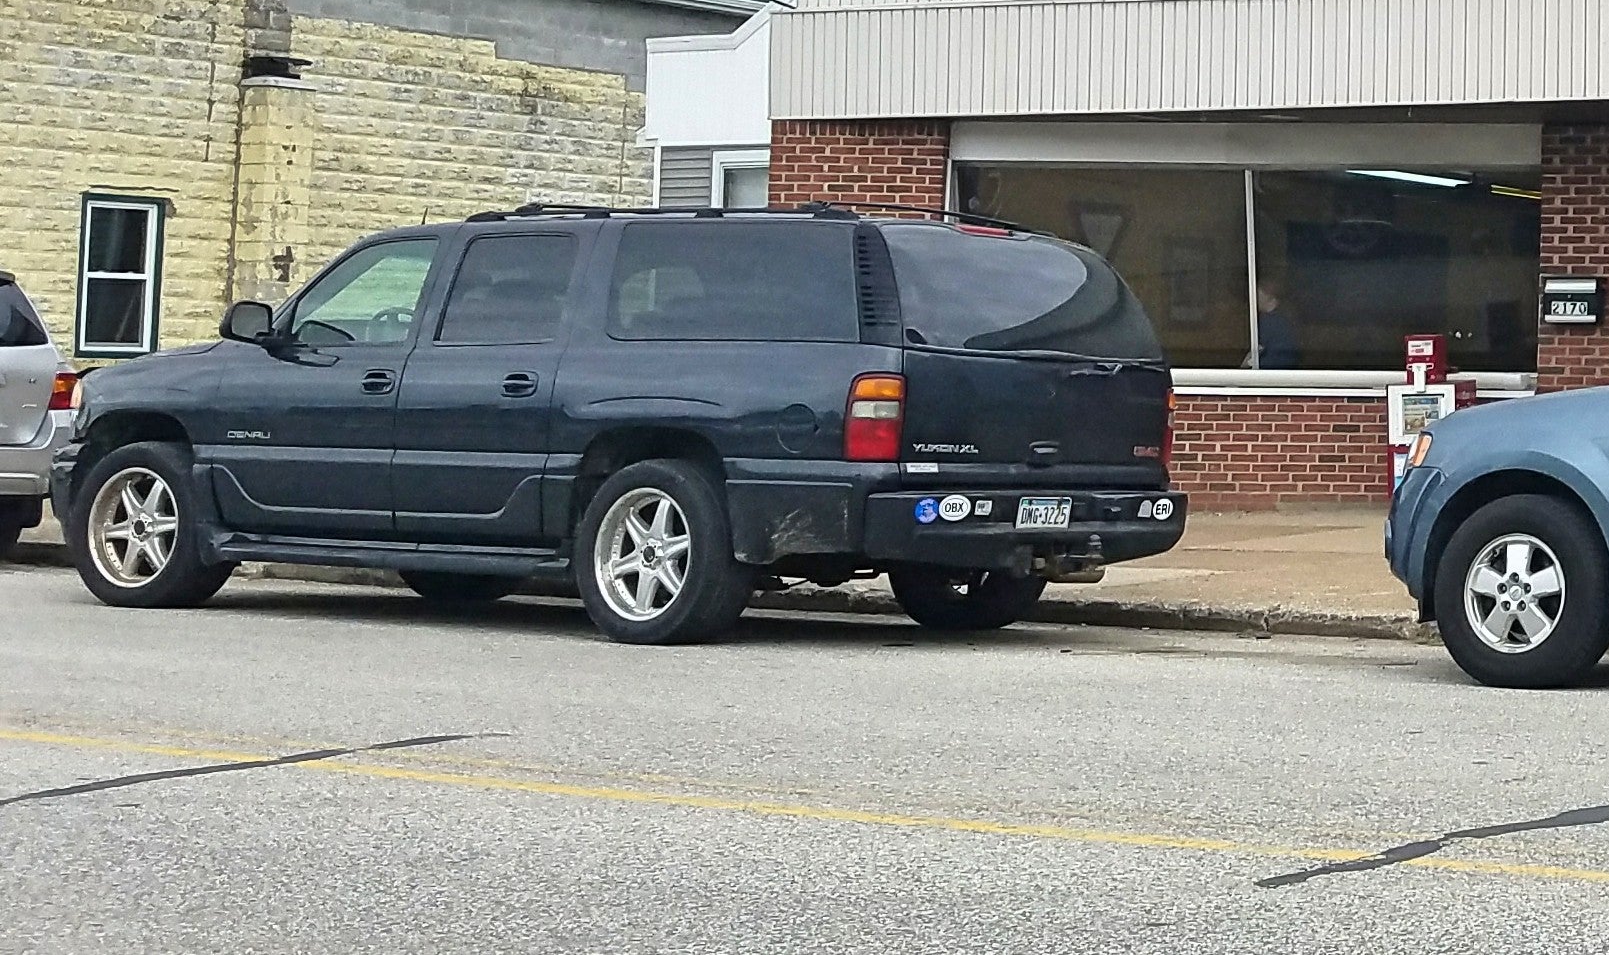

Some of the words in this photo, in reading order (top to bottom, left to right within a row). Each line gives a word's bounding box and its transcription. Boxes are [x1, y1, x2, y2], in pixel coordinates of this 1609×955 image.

[1552, 302, 1587, 315] 2170
[227, 430, 271, 439] DENALI
[912, 443, 959, 453] YUKON
[960, 444, 979, 454] XL
[944, 502, 965, 513] OBX
[1155, 502, 1171, 515] ERI
